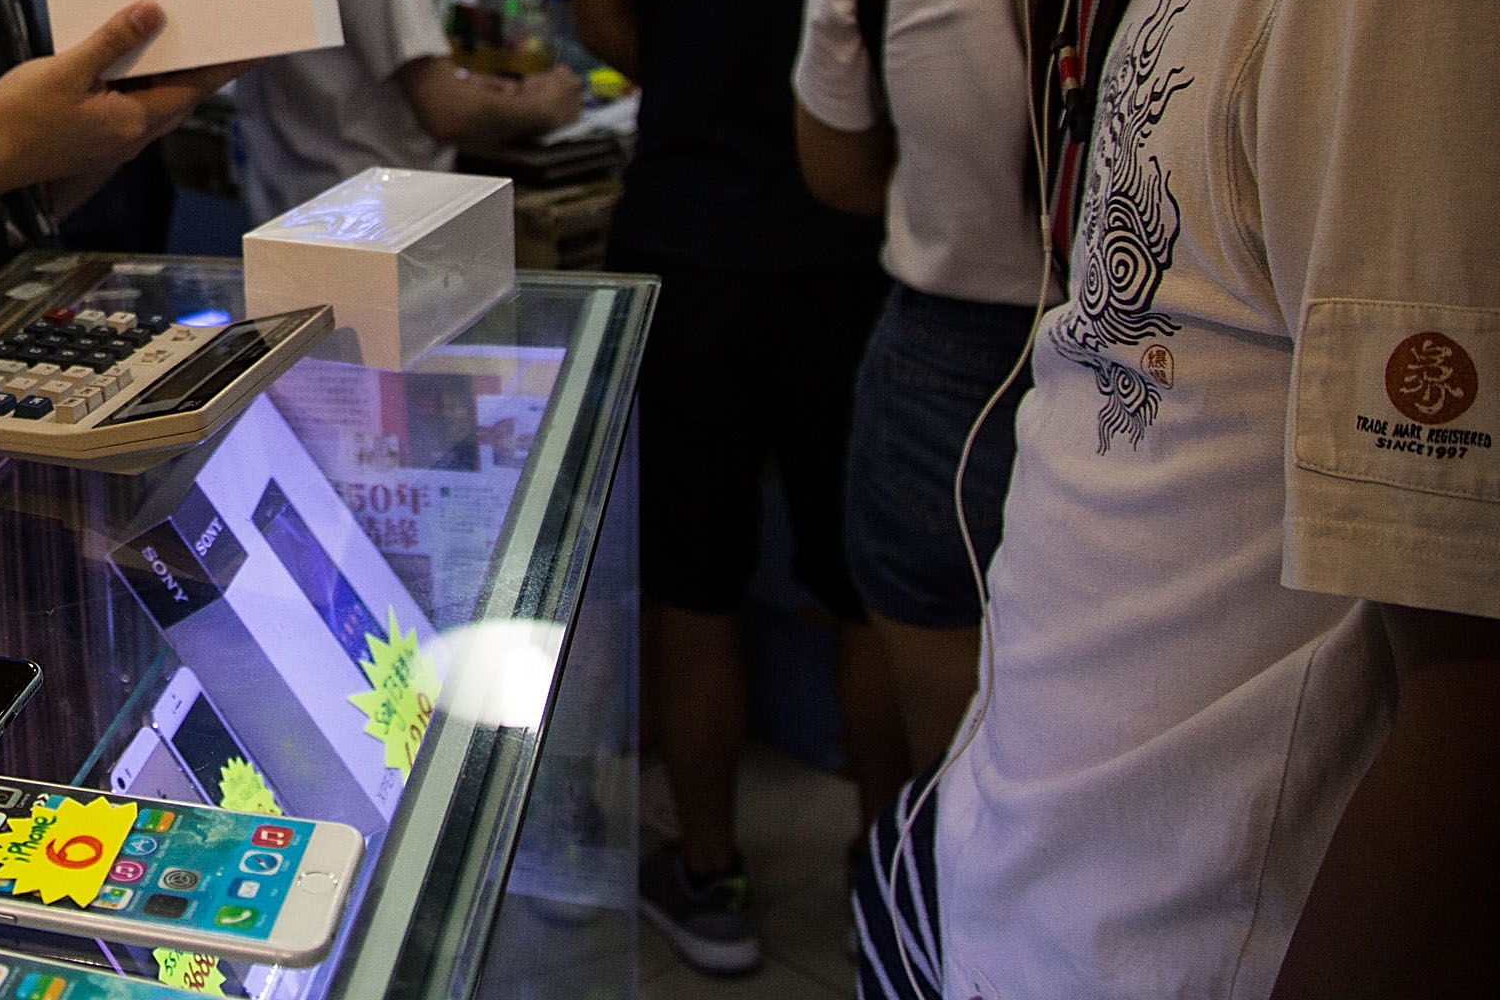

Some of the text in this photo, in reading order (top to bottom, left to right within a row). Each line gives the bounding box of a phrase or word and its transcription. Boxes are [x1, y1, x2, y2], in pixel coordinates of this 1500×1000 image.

[1356, 415, 1492, 448] TRADE MARK REGISTERED
[194, 515, 225, 557] SONY
[141, 546, 189, 604] SONY
[2, 813, 57, 864] iPhone
[46, 834, 105, 870] 6
